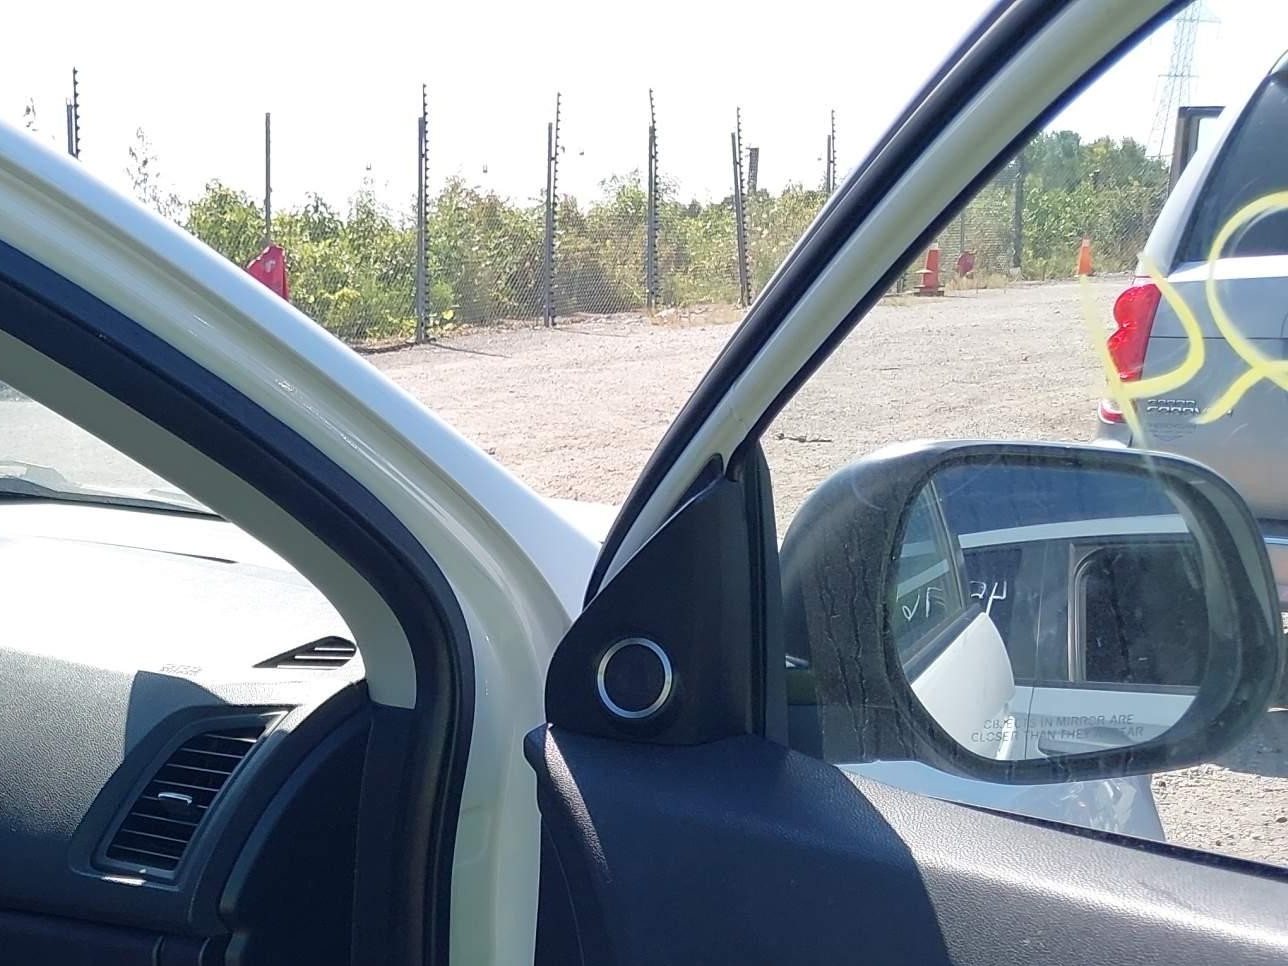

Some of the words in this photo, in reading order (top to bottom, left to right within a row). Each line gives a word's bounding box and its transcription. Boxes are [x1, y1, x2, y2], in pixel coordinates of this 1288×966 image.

[1041, 717, 1053, 728] IN
[1056, 715, 1105, 728] MIRROR
[1110, 713, 1135, 725] ARE
